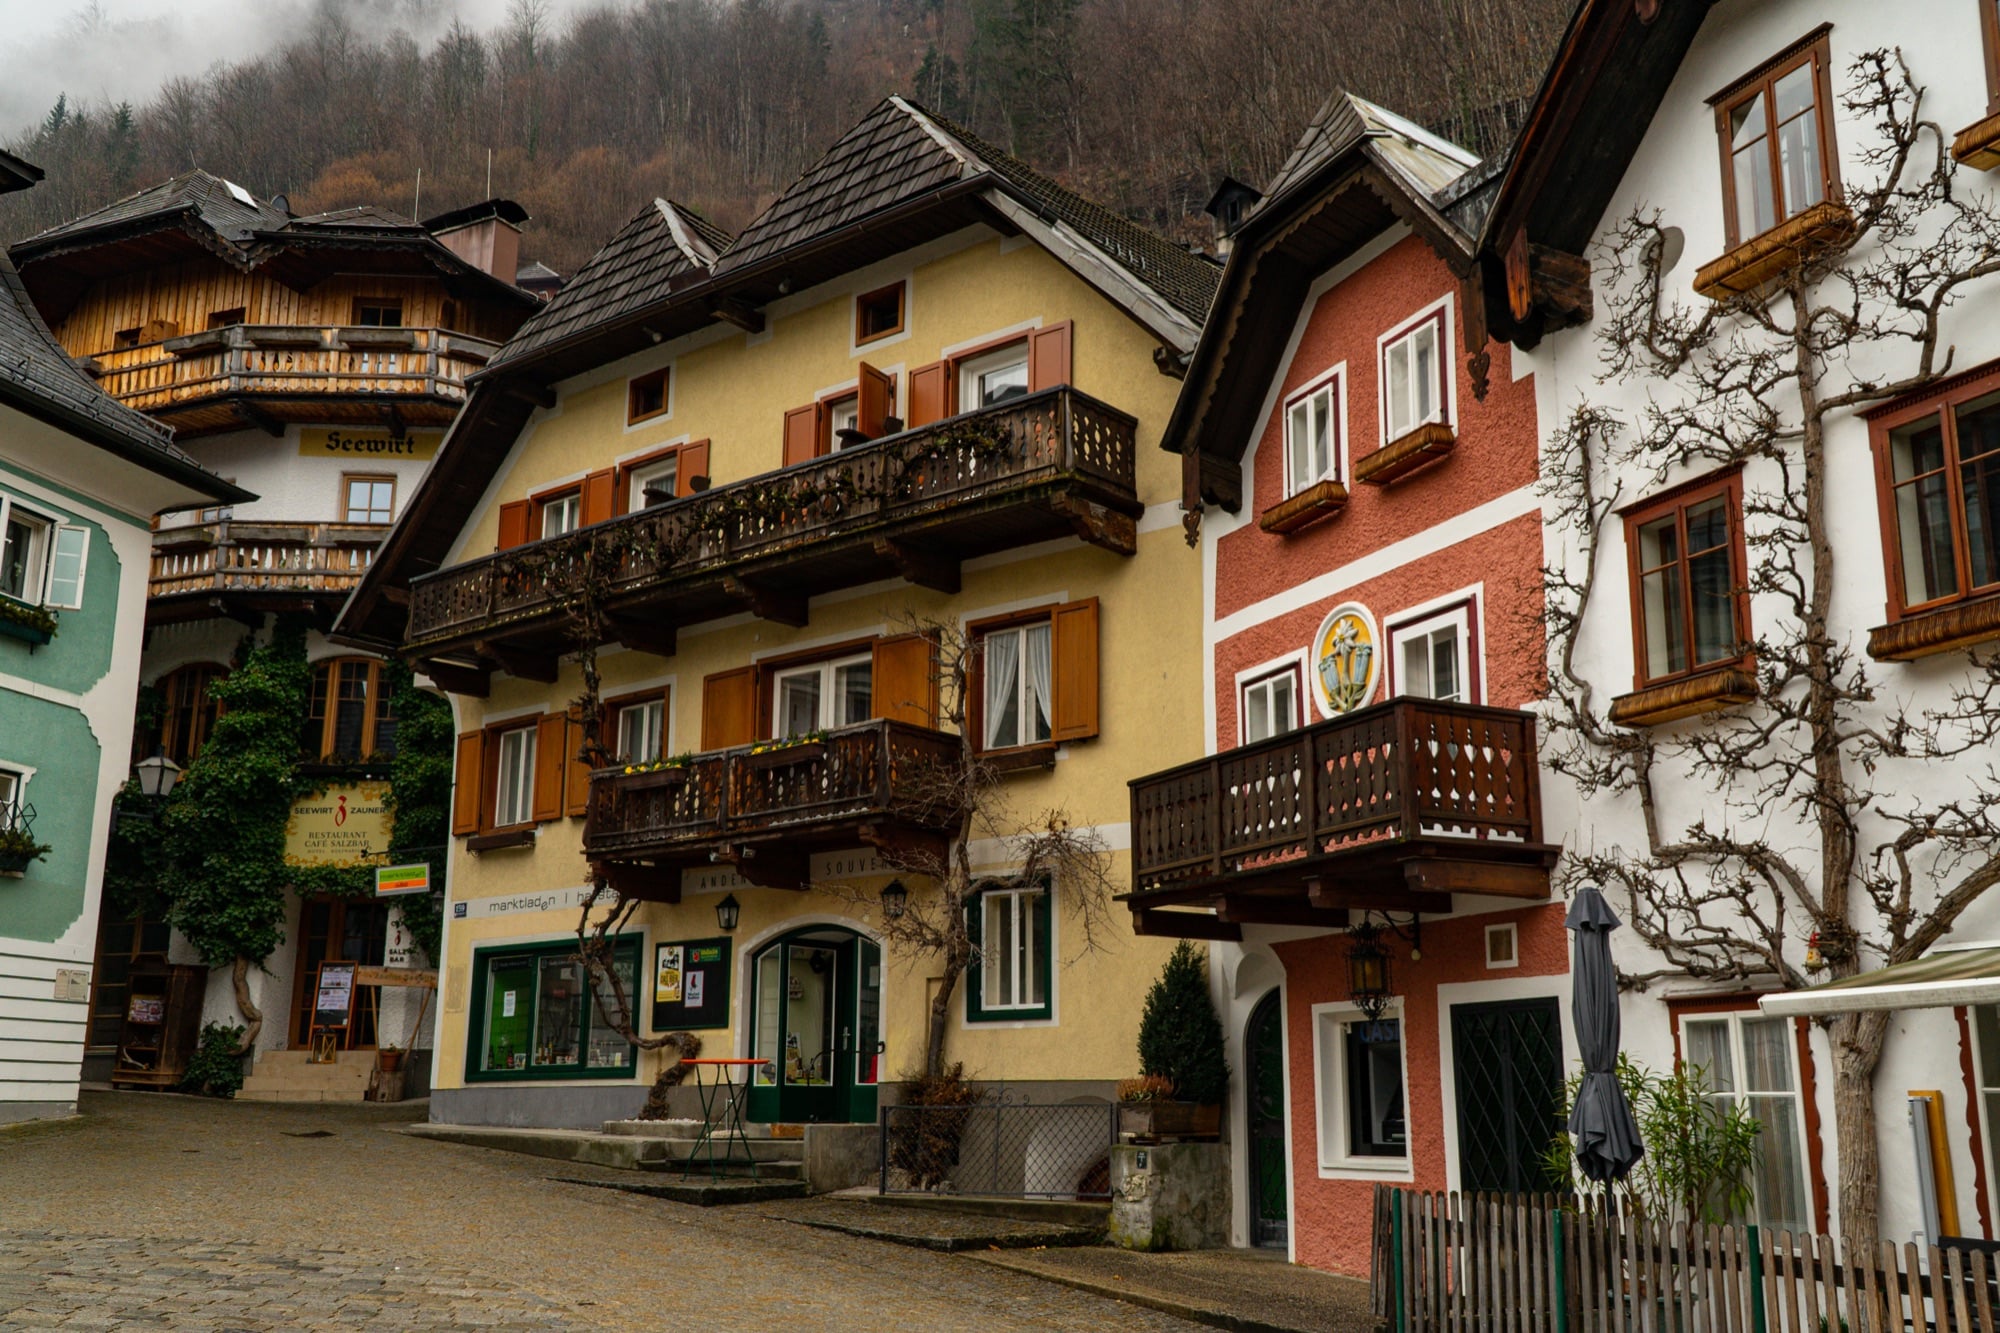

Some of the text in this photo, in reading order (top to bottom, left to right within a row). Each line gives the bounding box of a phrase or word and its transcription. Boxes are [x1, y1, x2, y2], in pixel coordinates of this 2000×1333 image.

[326, 431, 415, 454] Seewirt
[309, 831, 368, 839] RESTAURANT
[331, 840, 370, 848] SALZBAR
[700, 873, 747, 889] ANDEN
[489, 896, 556, 912] marktladen
